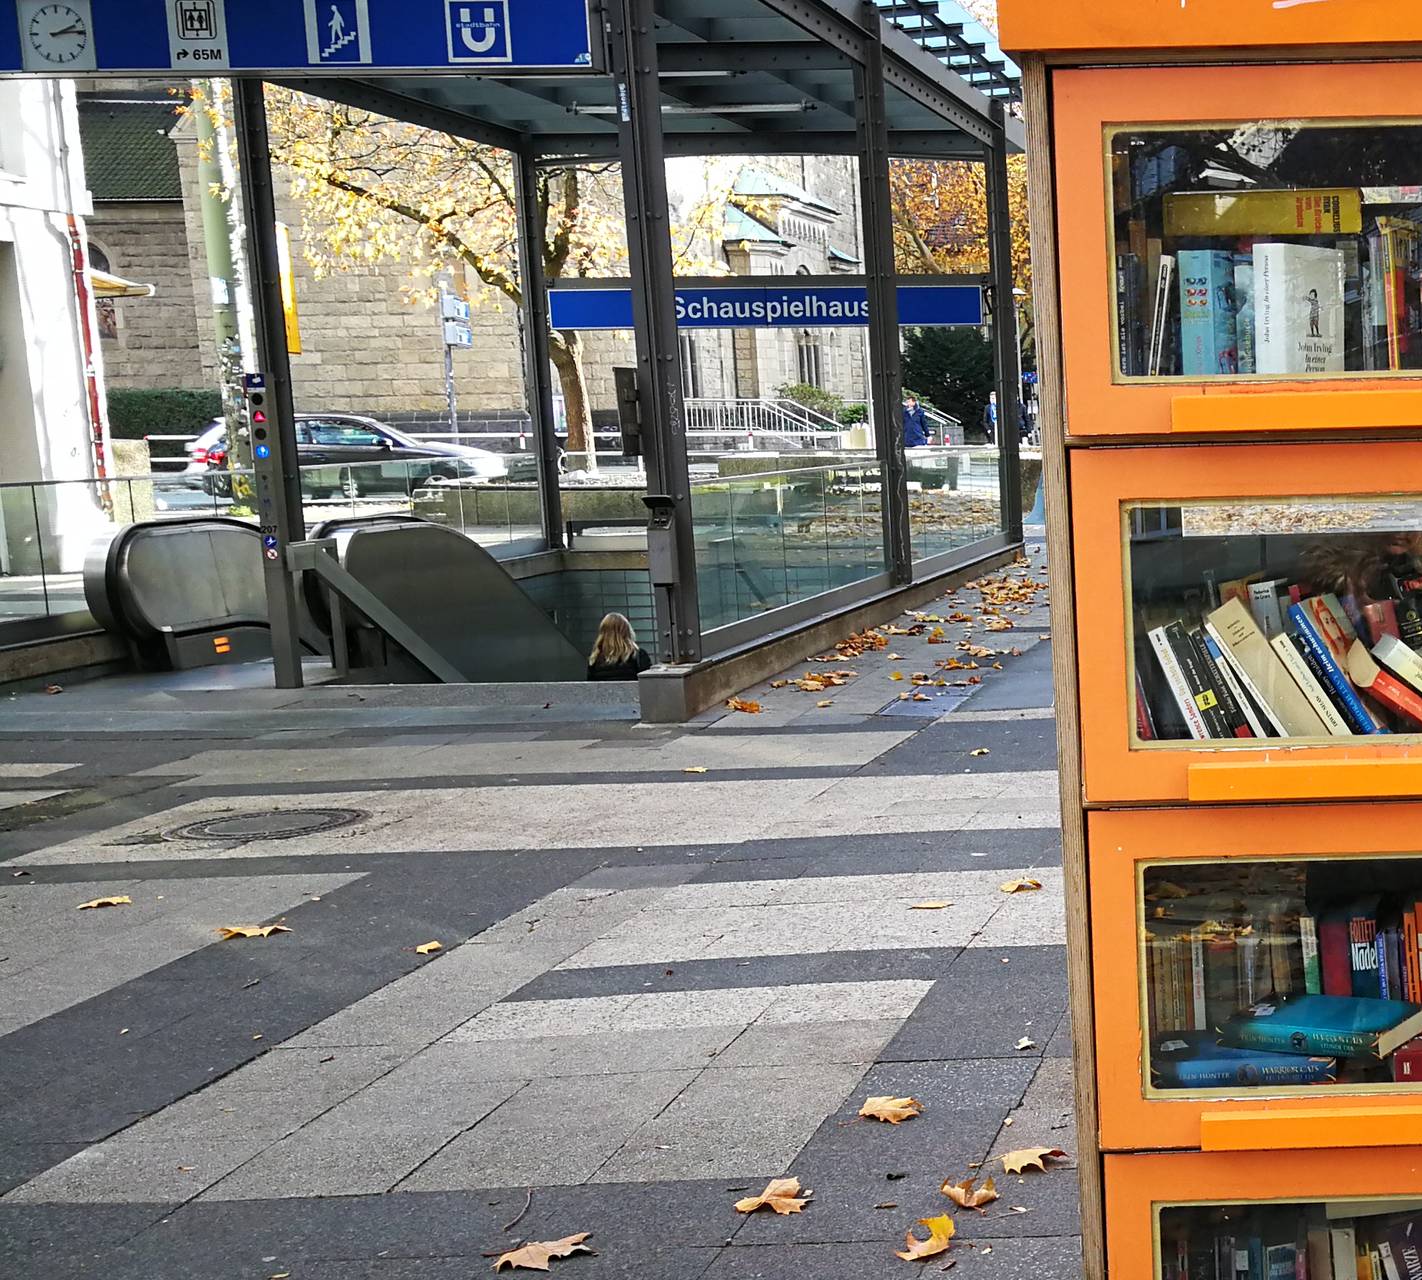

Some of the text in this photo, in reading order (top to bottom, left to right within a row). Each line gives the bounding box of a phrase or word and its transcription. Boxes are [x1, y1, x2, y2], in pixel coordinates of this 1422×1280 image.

[193, 49, 222, 60] 65M
[675, 295, 869, 322] Schauspielhaus
[1350, 920, 1377, 943] FOLLETT
[1351, 941, 1379, 971] Nadel
[1201, 1071, 1231, 1081] HUNTER
